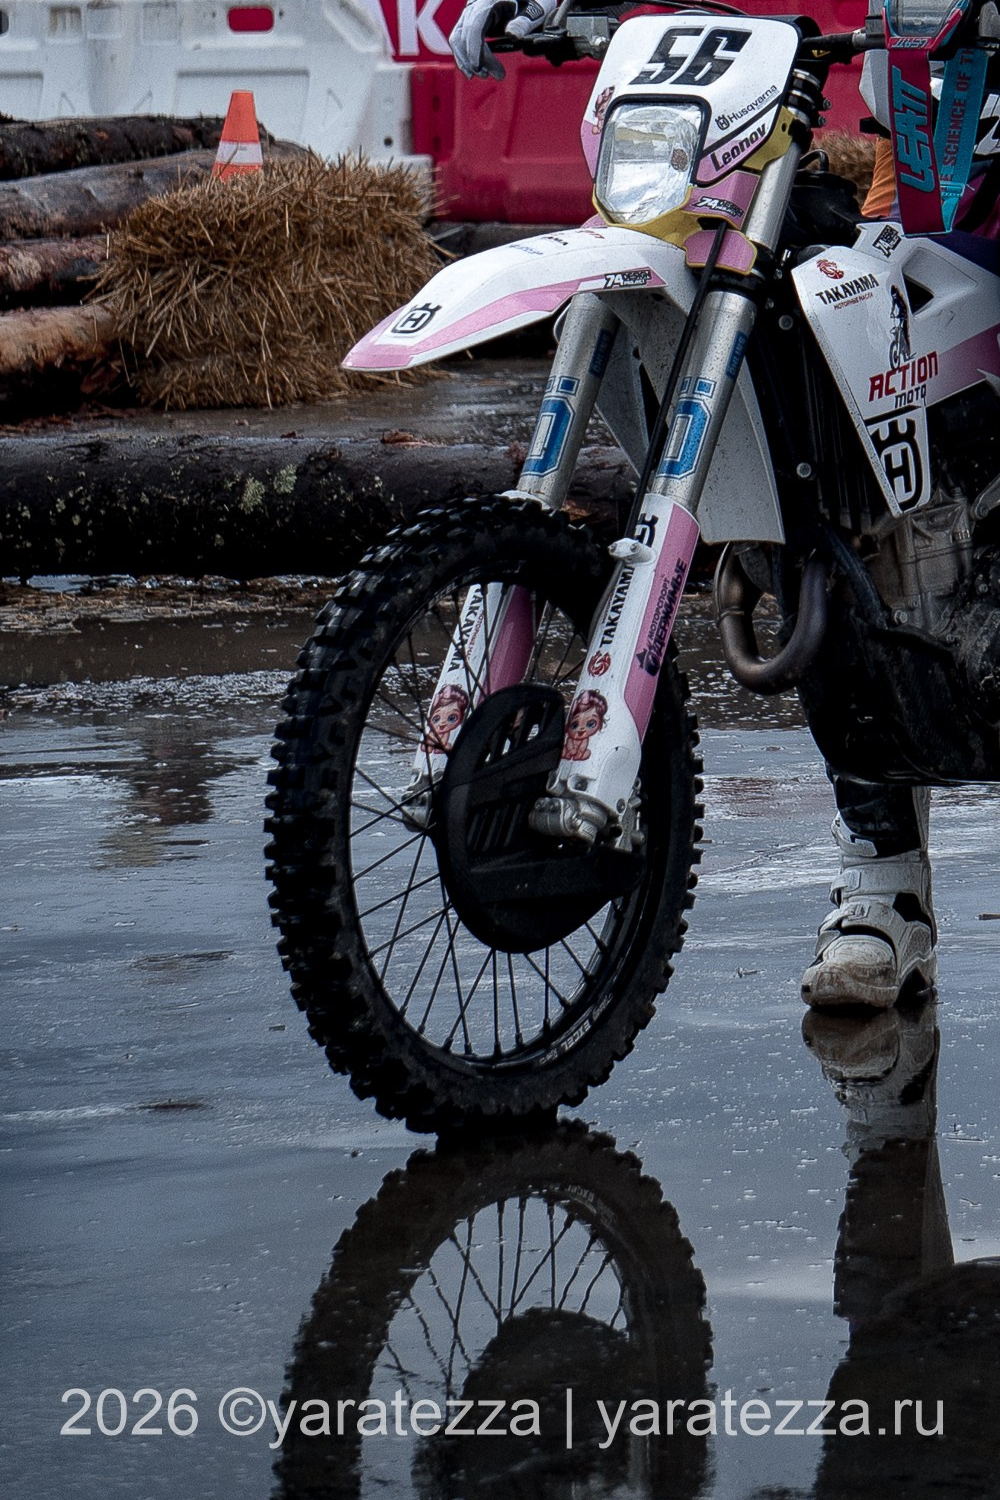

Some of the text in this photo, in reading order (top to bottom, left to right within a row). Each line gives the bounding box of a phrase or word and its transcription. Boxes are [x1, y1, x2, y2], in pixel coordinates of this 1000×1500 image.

[628, 25, 752, 86] 56
[728, 84, 778, 124] Husqvarna
[943, 99, 966, 167] SCIENCE
[956, 72, 972, 91] OF
[710, 123, 767, 171] Leonov
[892, 65, 935, 193] LEATT
[696, 197, 719, 209] 74
[605, 274, 624, 289] 74
[815, 273, 880, 306] TAKAYAMA
[869, 351, 939, 402] ACTION
[650, 576, 670, 640] МОТОРСПОРТ
